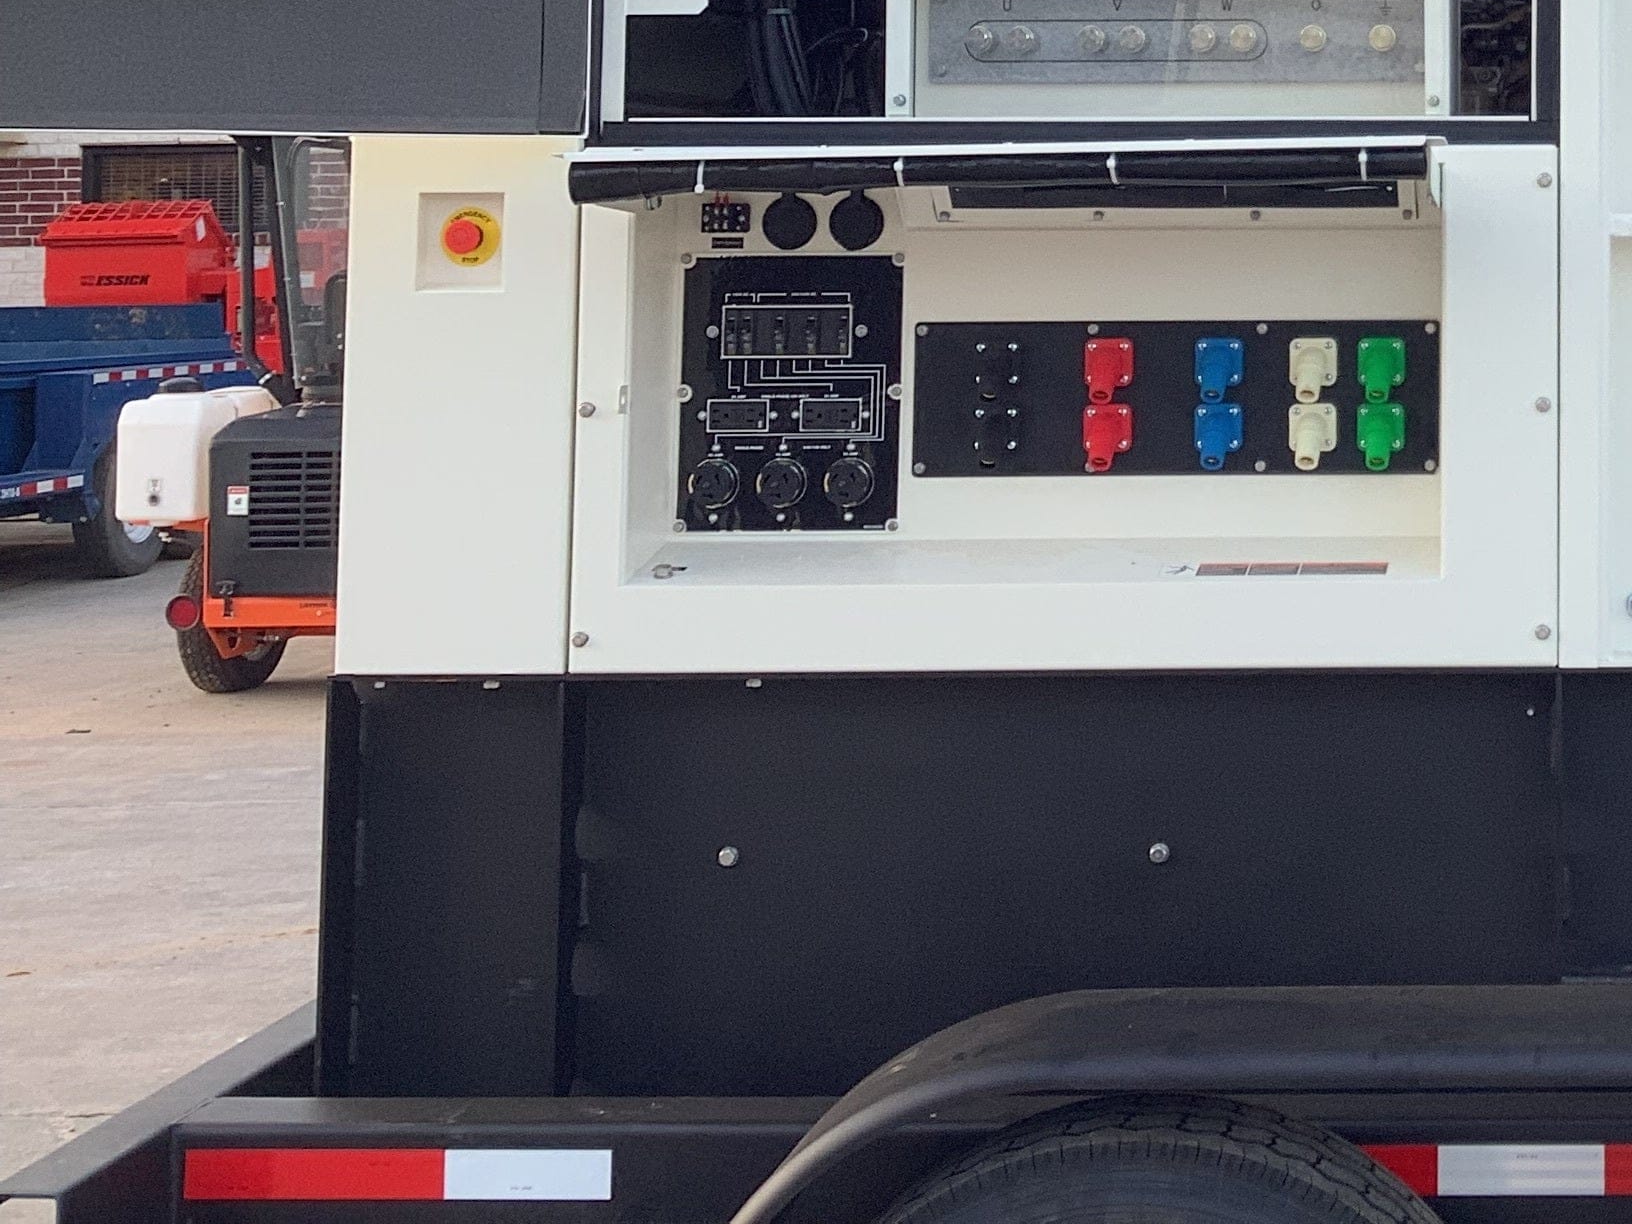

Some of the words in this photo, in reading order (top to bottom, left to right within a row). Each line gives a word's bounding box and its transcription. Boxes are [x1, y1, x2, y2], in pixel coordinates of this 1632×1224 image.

[1002, 0, 1012, 12] U
[1112, 0, 1122, 12] V
[1221, 0, 1233, 12] W
[96, 275, 151, 287] ESSICK
